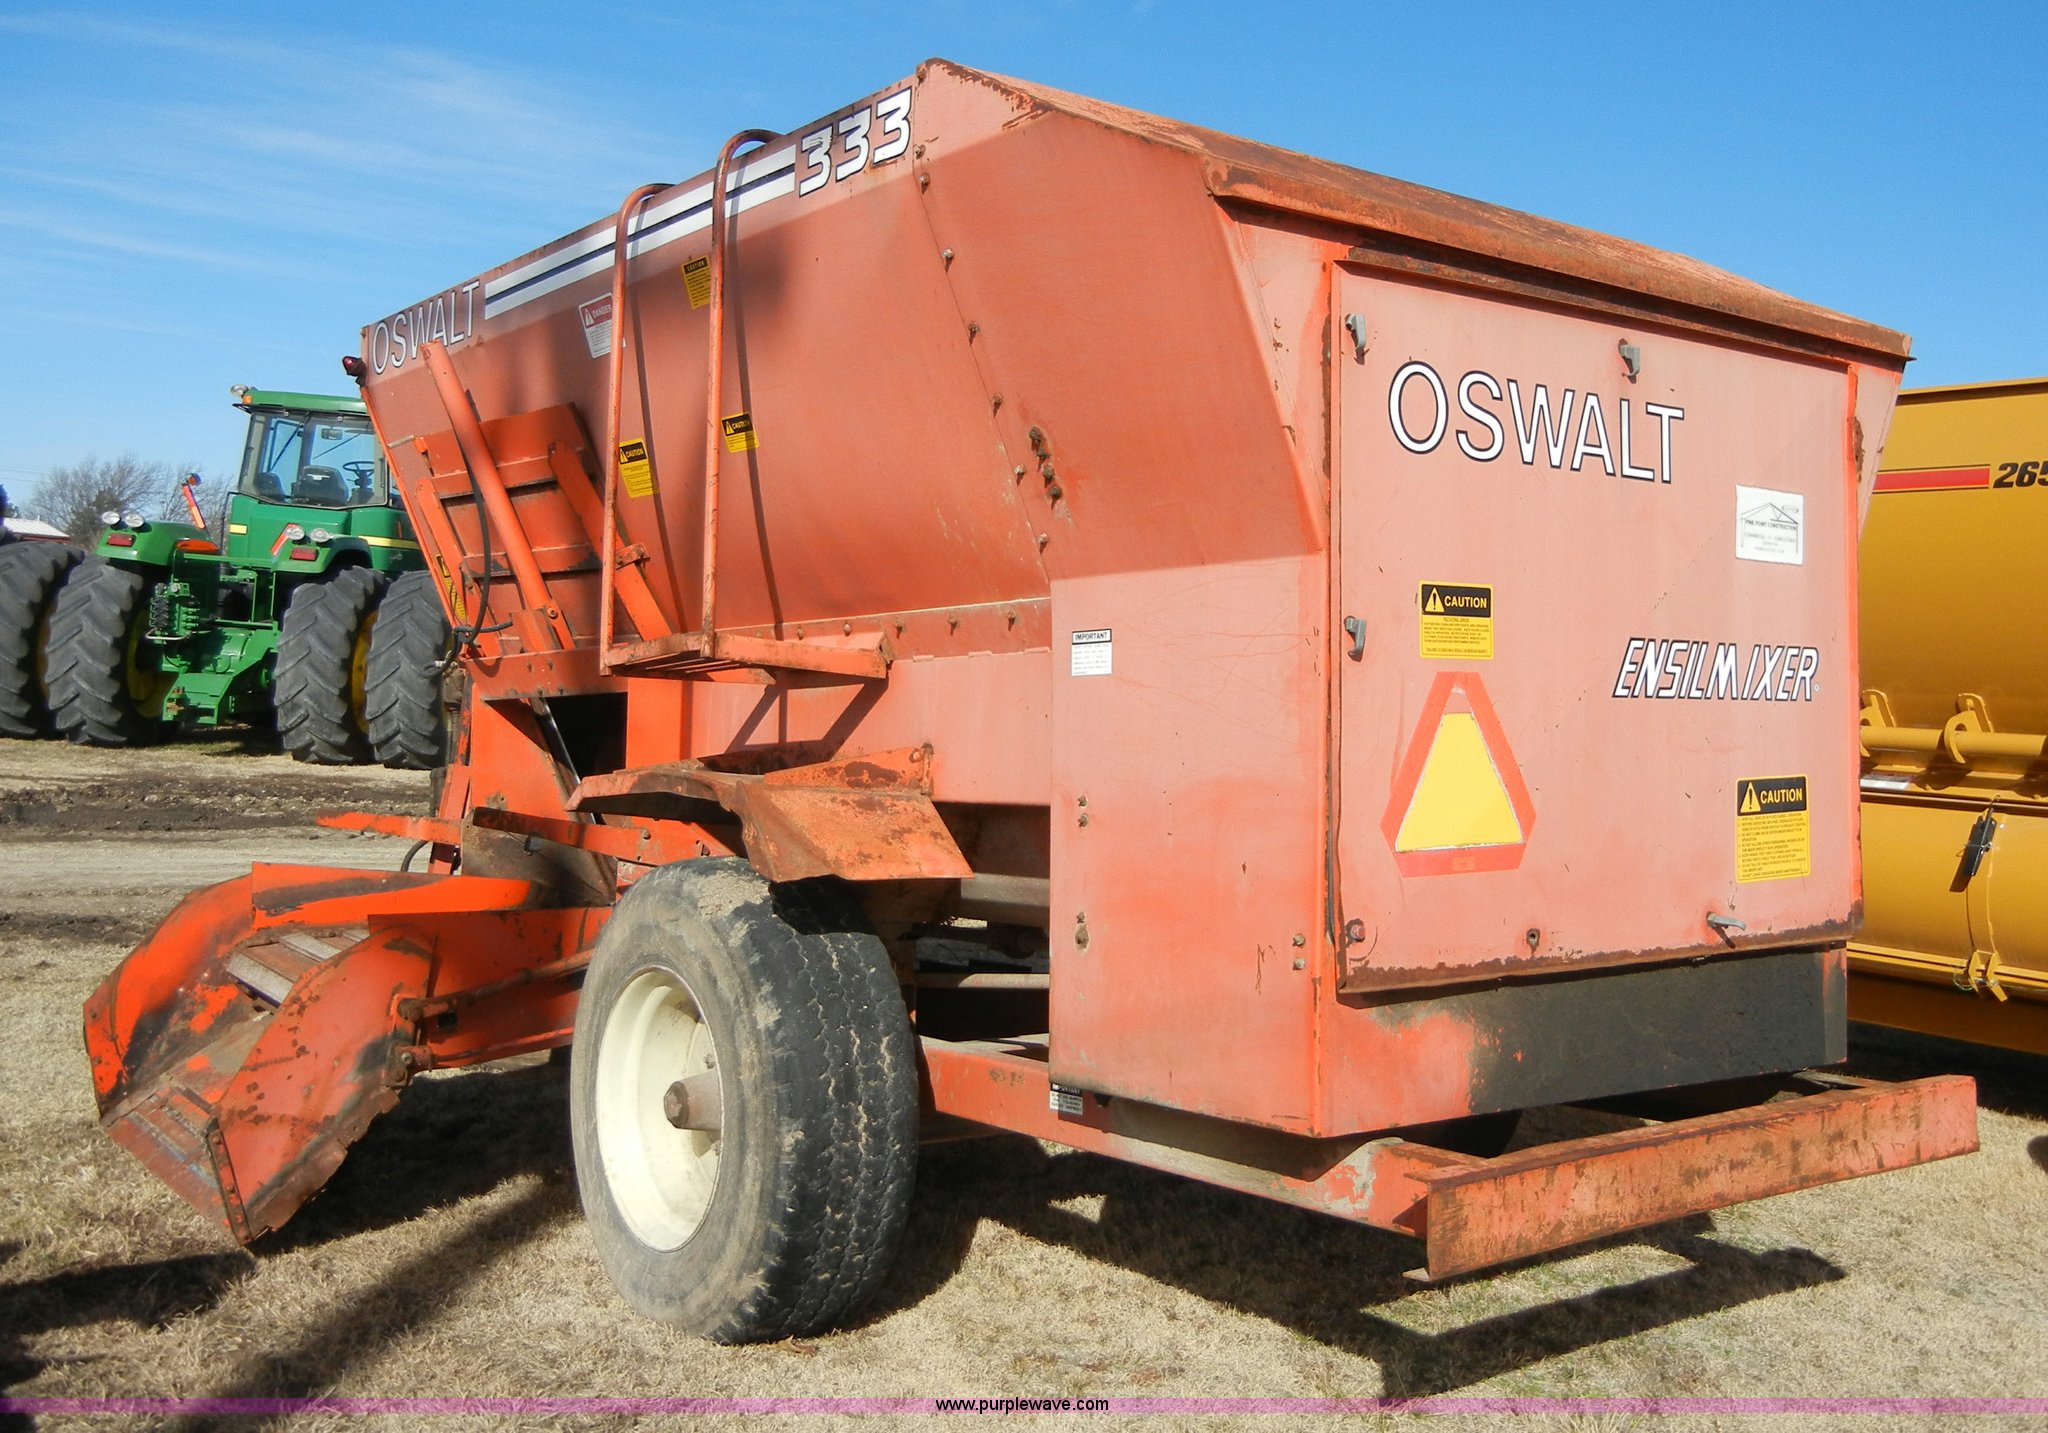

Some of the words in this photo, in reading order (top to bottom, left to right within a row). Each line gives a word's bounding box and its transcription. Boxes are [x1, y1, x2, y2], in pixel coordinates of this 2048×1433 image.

[799, 86, 912, 198] 333
[373, 279, 480, 375] OSWALT
[1388, 360, 1685, 484] OSWALT
[1444, 595, 1487, 609] CAUTION
[1075, 631, 1108, 641] IMPORTANT
[1612, 637, 1819, 701] ENSILMIXER
[1760, 788, 1803, 804] CAUTION
